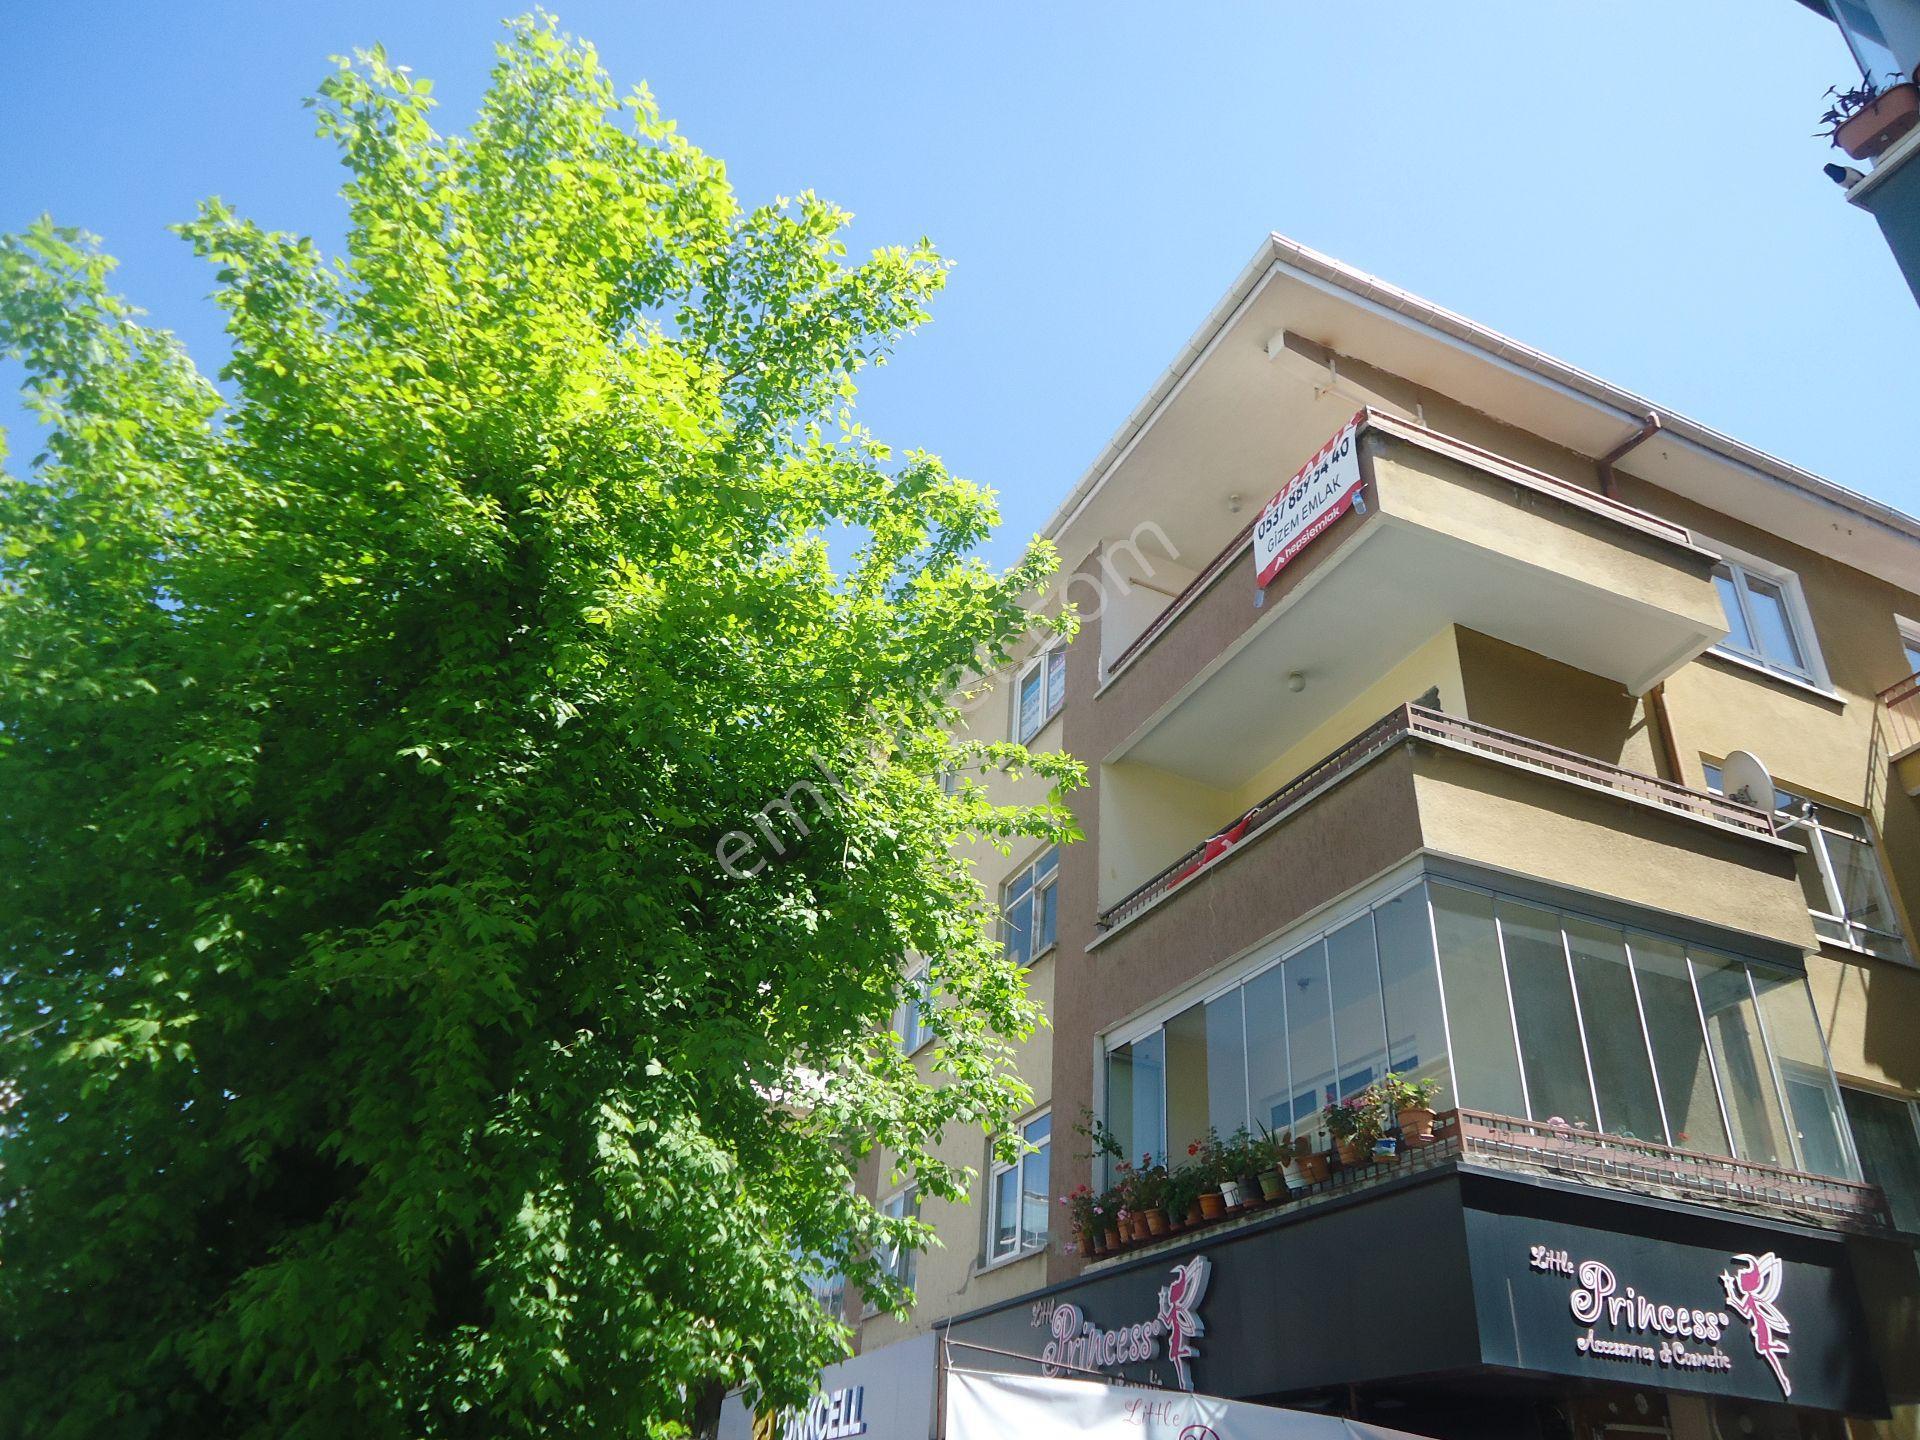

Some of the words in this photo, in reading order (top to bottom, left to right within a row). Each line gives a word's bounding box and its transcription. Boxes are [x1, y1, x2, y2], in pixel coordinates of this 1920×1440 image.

[1258, 502, 1285, 540] 0537
[1332, 437, 1350, 463] 40
[1267, 516, 1300, 553] GİZEM
[1301, 473, 1342, 522] EMLAK
[1284, 506, 1341, 559] hepsiemlak
[1530, 1245, 1574, 1274] Little
[1570, 1260, 1721, 1341] Princess
[1042, 1303, 1152, 1378] Princess
[1122, 1398, 1181, 1427] Little
